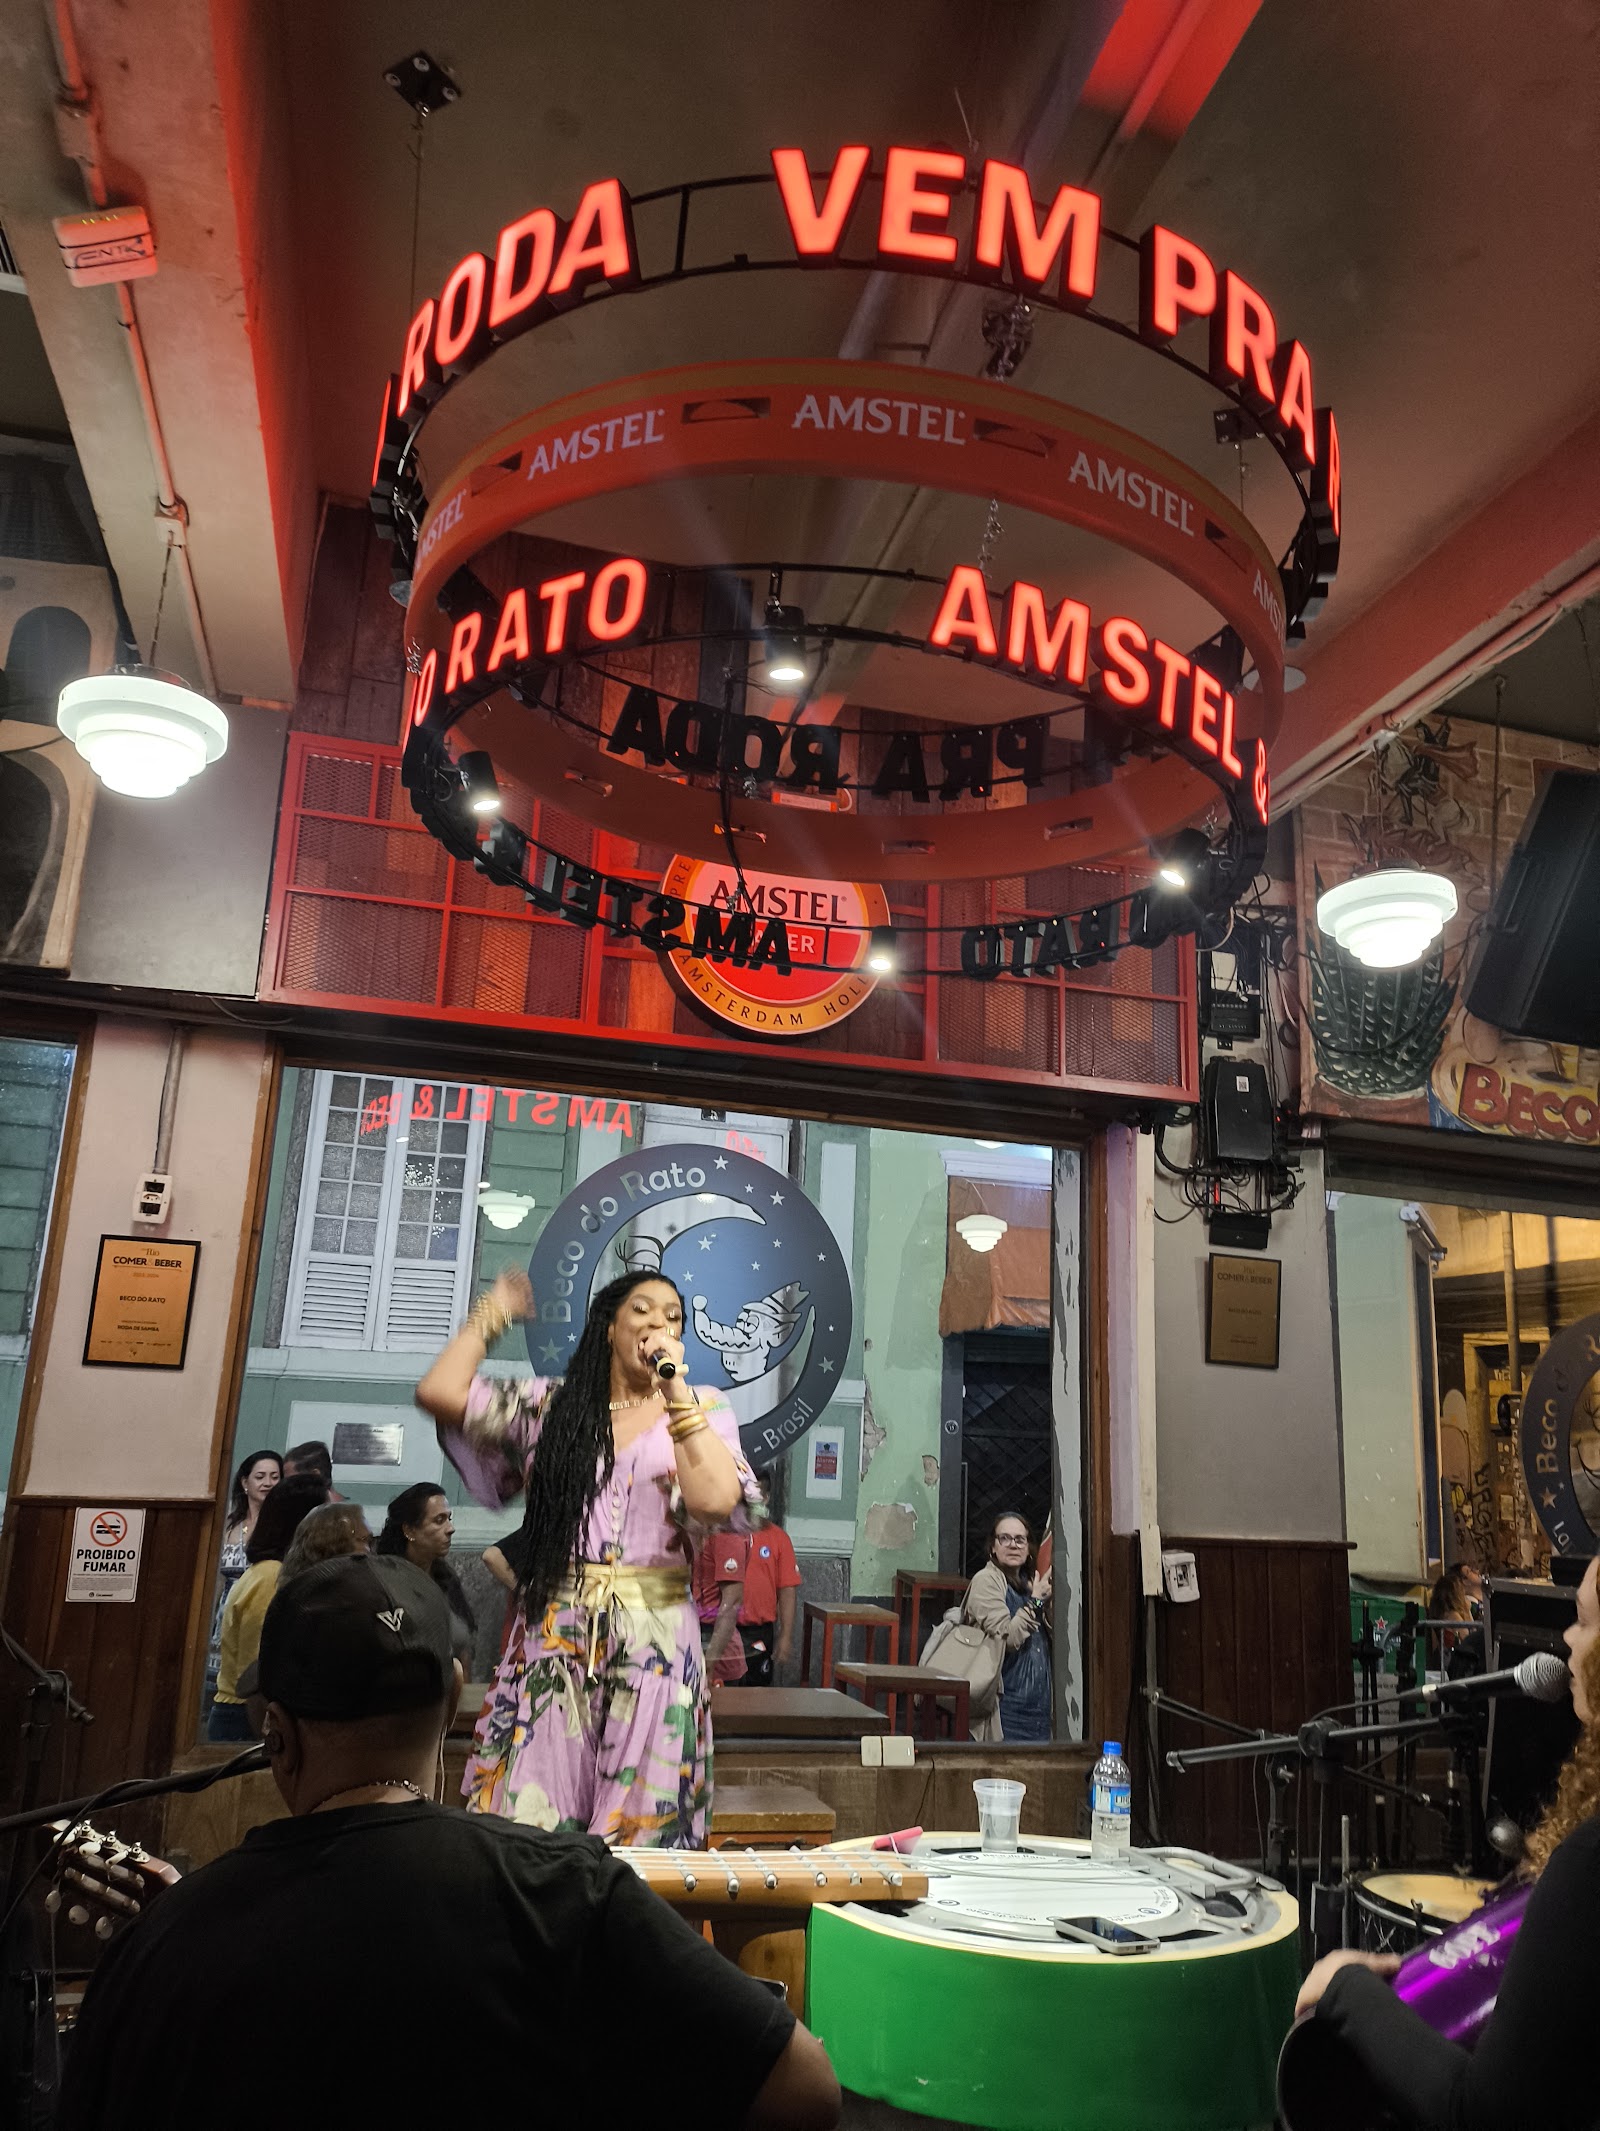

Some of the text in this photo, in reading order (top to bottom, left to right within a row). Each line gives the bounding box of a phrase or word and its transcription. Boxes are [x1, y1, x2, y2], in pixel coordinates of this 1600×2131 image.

[397, 177, 631, 418] RODA
[771, 145, 1316, 466] VEM PRA
[527, 408, 667, 481] AMSTEL
[790, 393, 967, 446] AMSTEL
[1068, 450, 1196, 538] AMSTEL
[444, 558, 648, 695] RATO
[929, 564, 1243, 780] AMSTEL
[710, 879, 848, 925] AMSTEL
[679, 953, 869, 1026] AMSTERDAM HOLL
[1458, 1062, 1600, 1141] BECO
[113, 1256, 148, 1266] COMER
[154, 1258, 182, 1269] BEBER
[541, 1162, 707, 1324] Beco do Rato
[762, 1397, 814, 1450] Brasil
[1536, 1398, 1559, 1475] Beco
[76, 1549, 136, 1560] PROIBIDO
[83, 1561, 126, 1572] FUMAR
